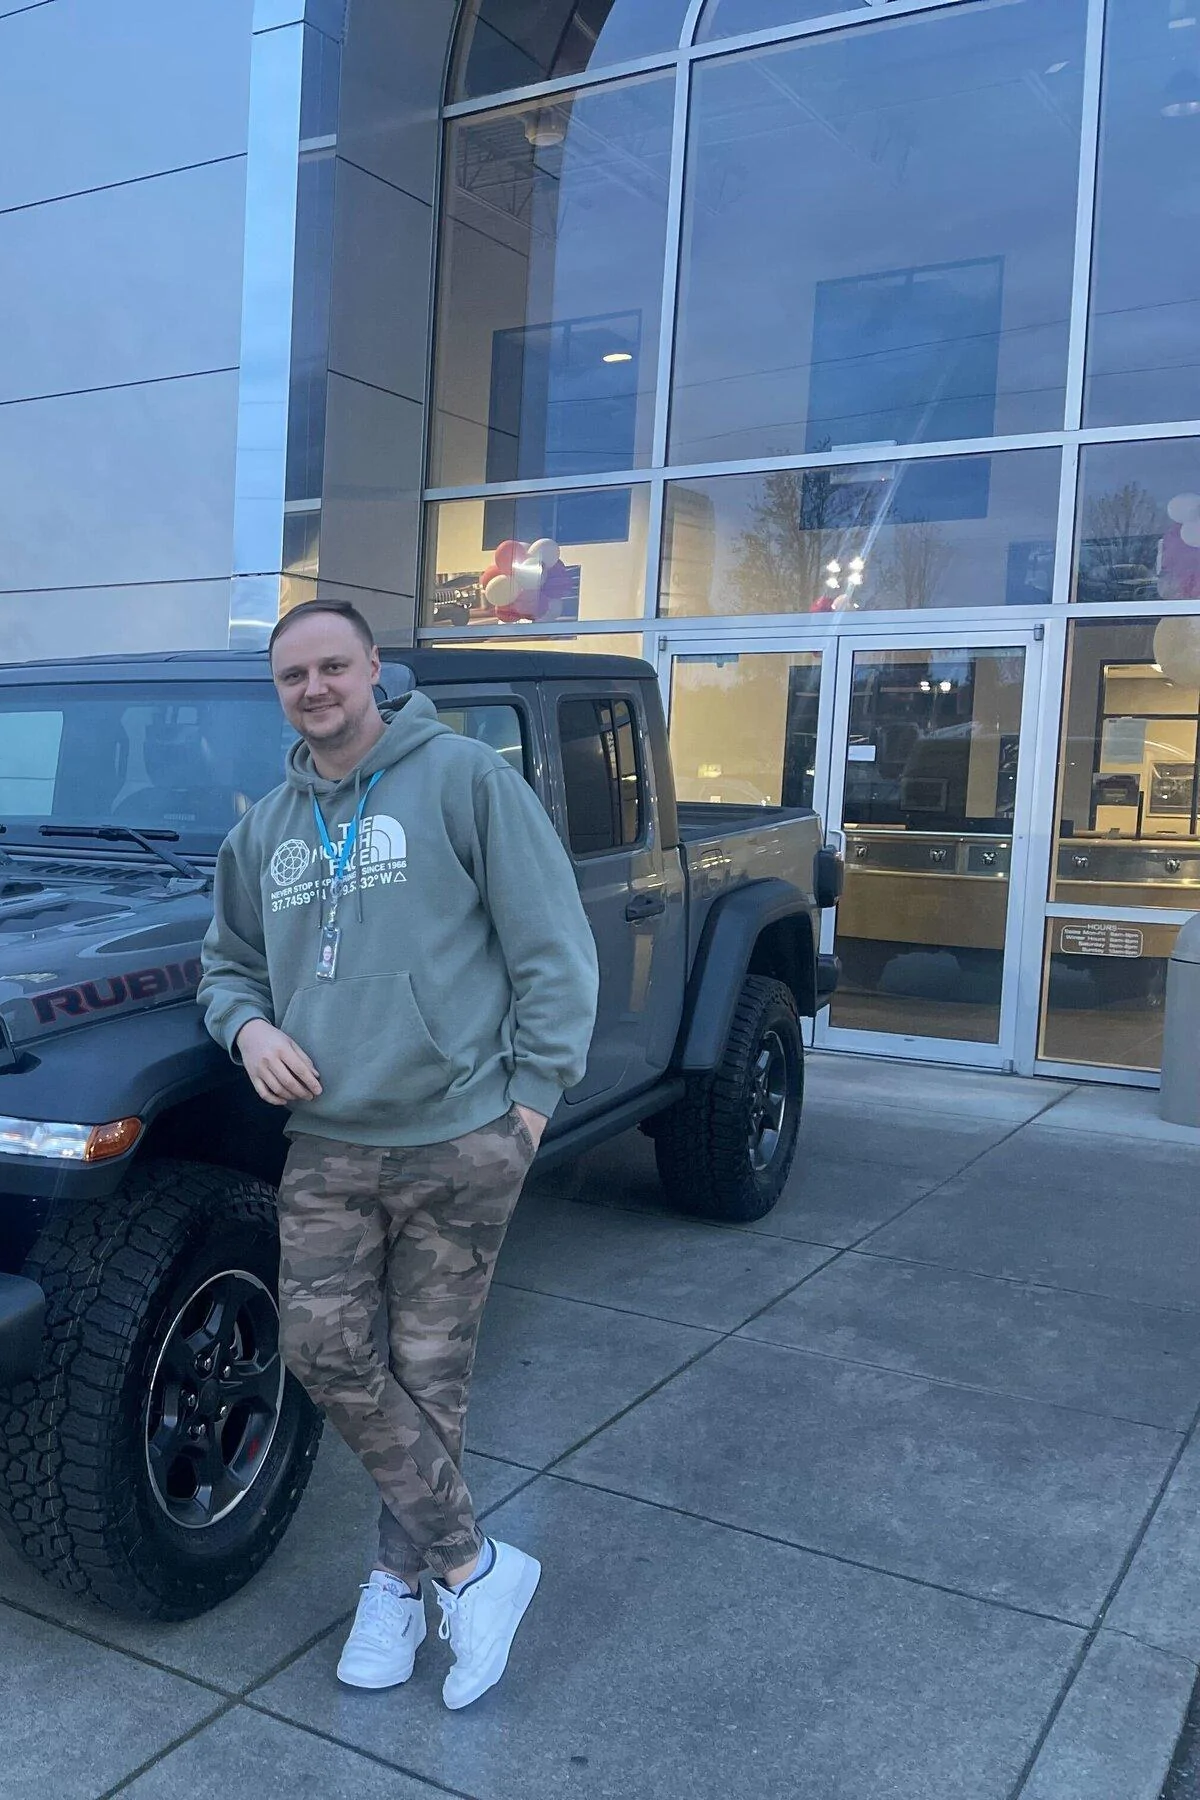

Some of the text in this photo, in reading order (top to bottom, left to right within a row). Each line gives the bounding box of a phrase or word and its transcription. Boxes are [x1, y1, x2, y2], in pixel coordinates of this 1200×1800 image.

[338, 816, 373, 840] TE
[271, 886, 293, 900] NEVER
[293, 881, 314, 893] STOP
[362, 864, 386, 875] SINCE
[1087, 924, 1117, 932] HOURS
